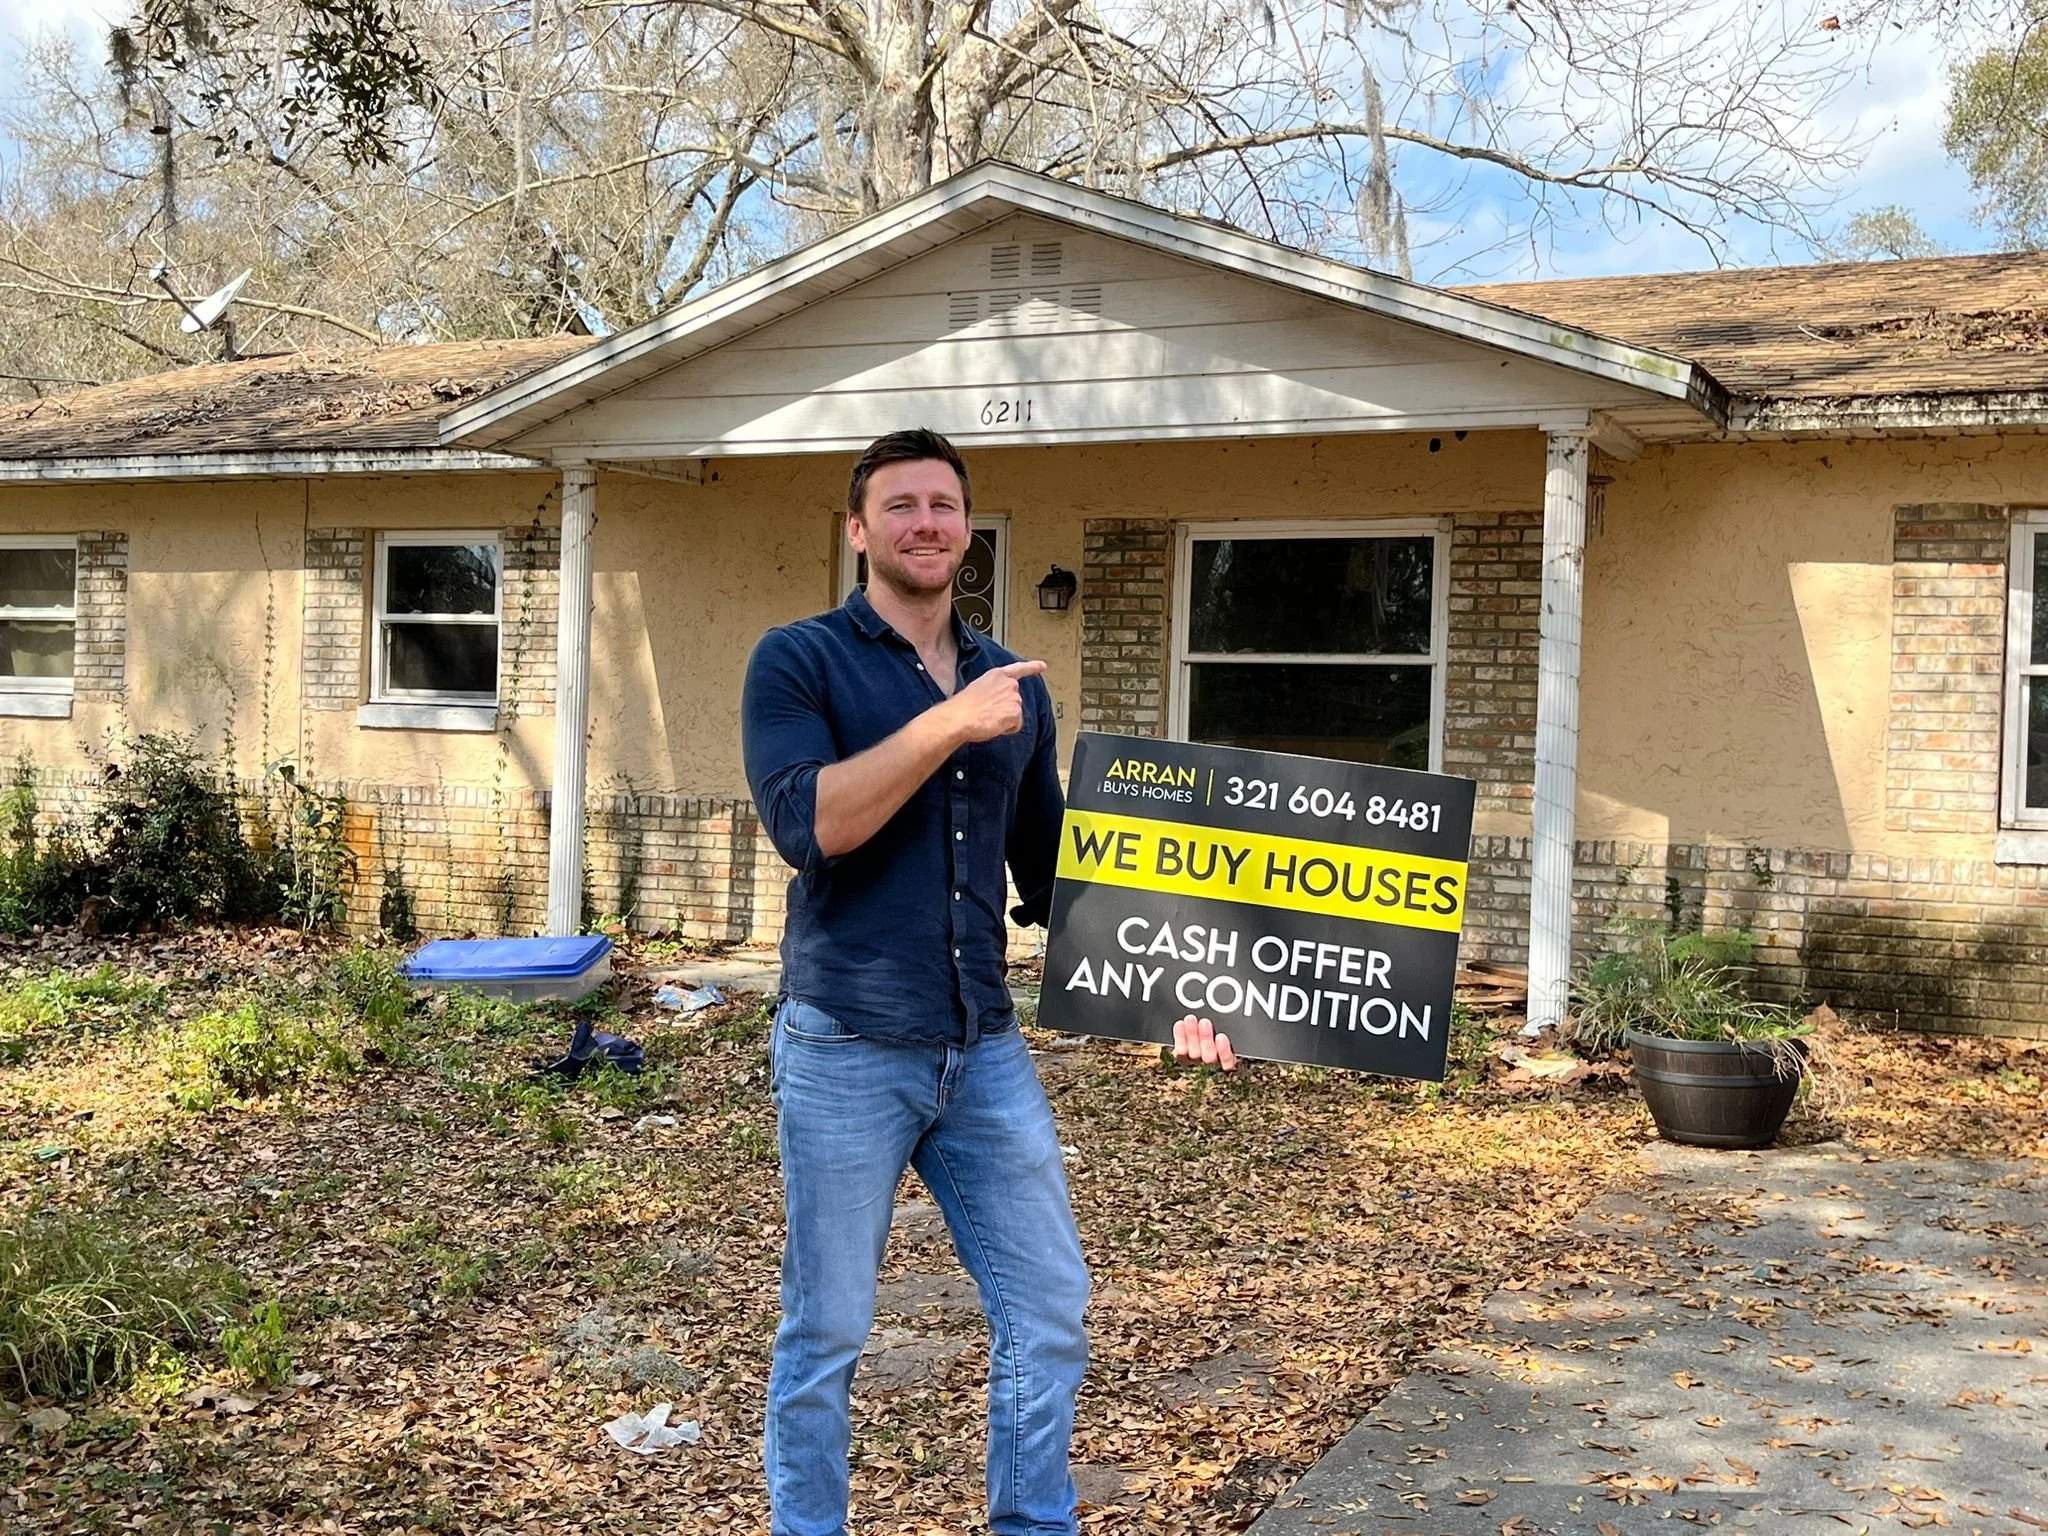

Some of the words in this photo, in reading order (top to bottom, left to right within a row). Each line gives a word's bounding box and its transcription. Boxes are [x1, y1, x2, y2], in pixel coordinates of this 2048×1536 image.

[981, 399, 1032, 426] 6211
[1102, 780, 1139, 797] BUYS
[1141, 785, 1193, 804] HOMES
[1106, 758, 1196, 788] ARRAN
[1223, 776, 1279, 811] 321
[1288, 785, 1357, 821] 604
[1365, 795, 1441, 833] 8481
[1072, 825, 1142, 871] WE
[1155, 837, 1252, 885] BUY
[1264, 851, 1459, 915] HOUSES
[1116, 916, 1239, 968] CASH
[1251, 935, 1392, 990] OFFER
[1065, 956, 1165, 1002] ANY
[1175, 970, 1432, 1042] CONDITION
